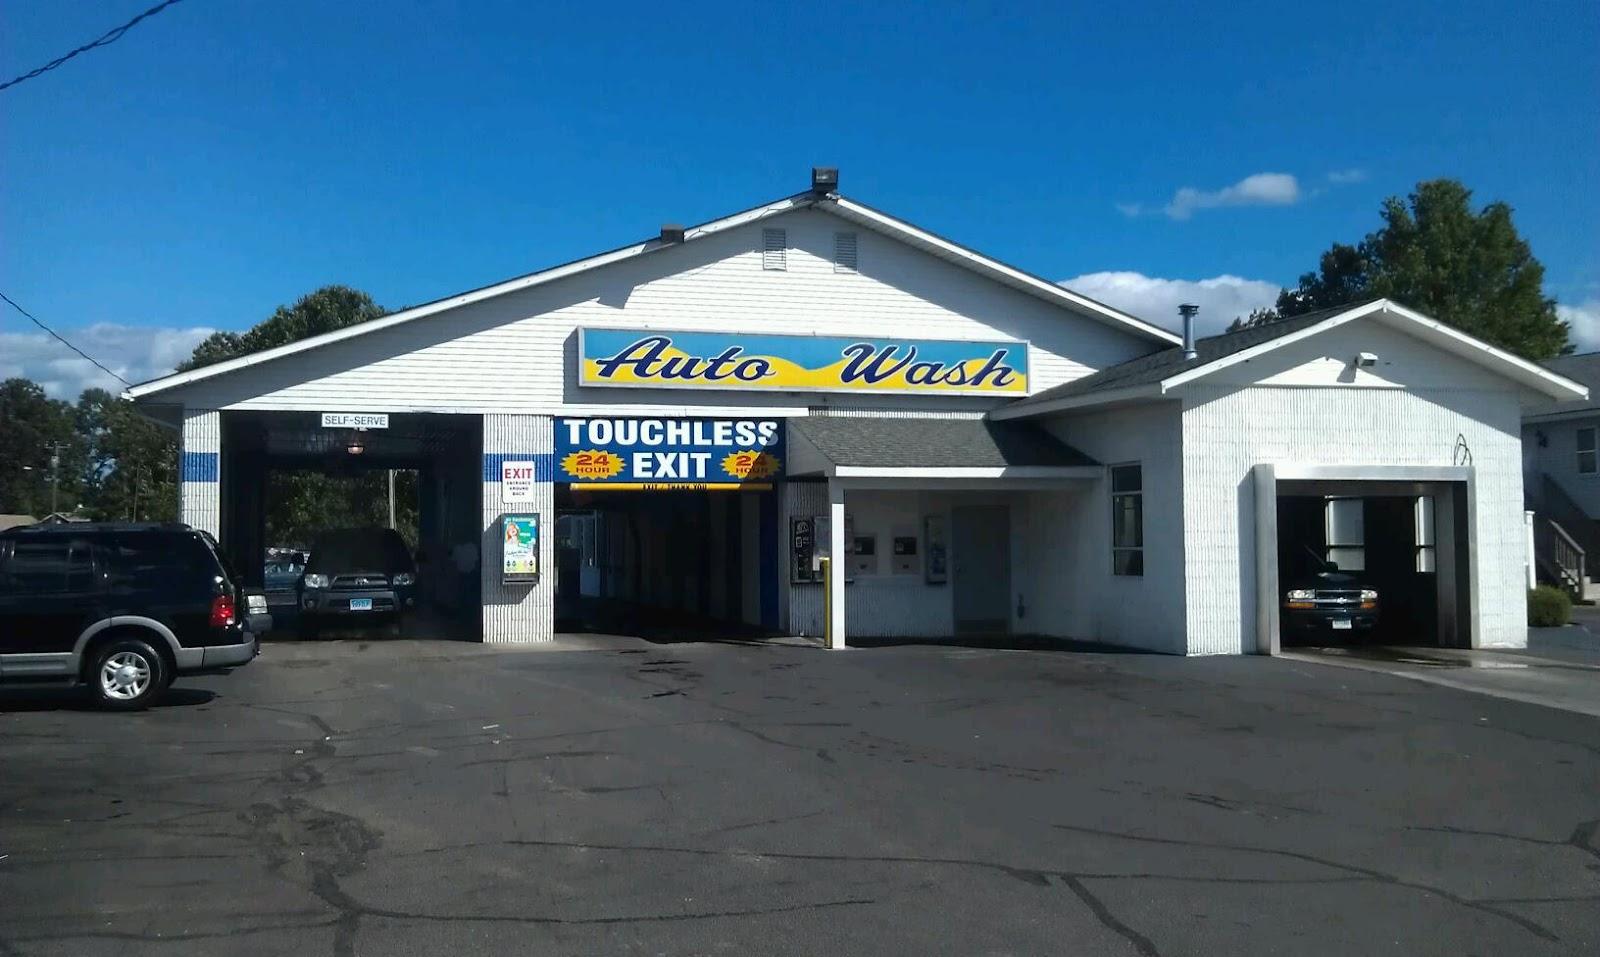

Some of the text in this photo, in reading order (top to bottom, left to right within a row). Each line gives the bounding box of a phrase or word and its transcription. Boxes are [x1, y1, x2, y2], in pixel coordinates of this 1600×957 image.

[595, 335, 1015, 387] Auto Wash
[324, 415, 386, 426] SELF-SERVE
[563, 419, 778, 446] TOUCHLESS
[576, 454, 609, 466] 24
[633, 452, 712, 478] EXIT
[735, 454, 768, 466] 24
[504, 468, 533, 479] EXIT
